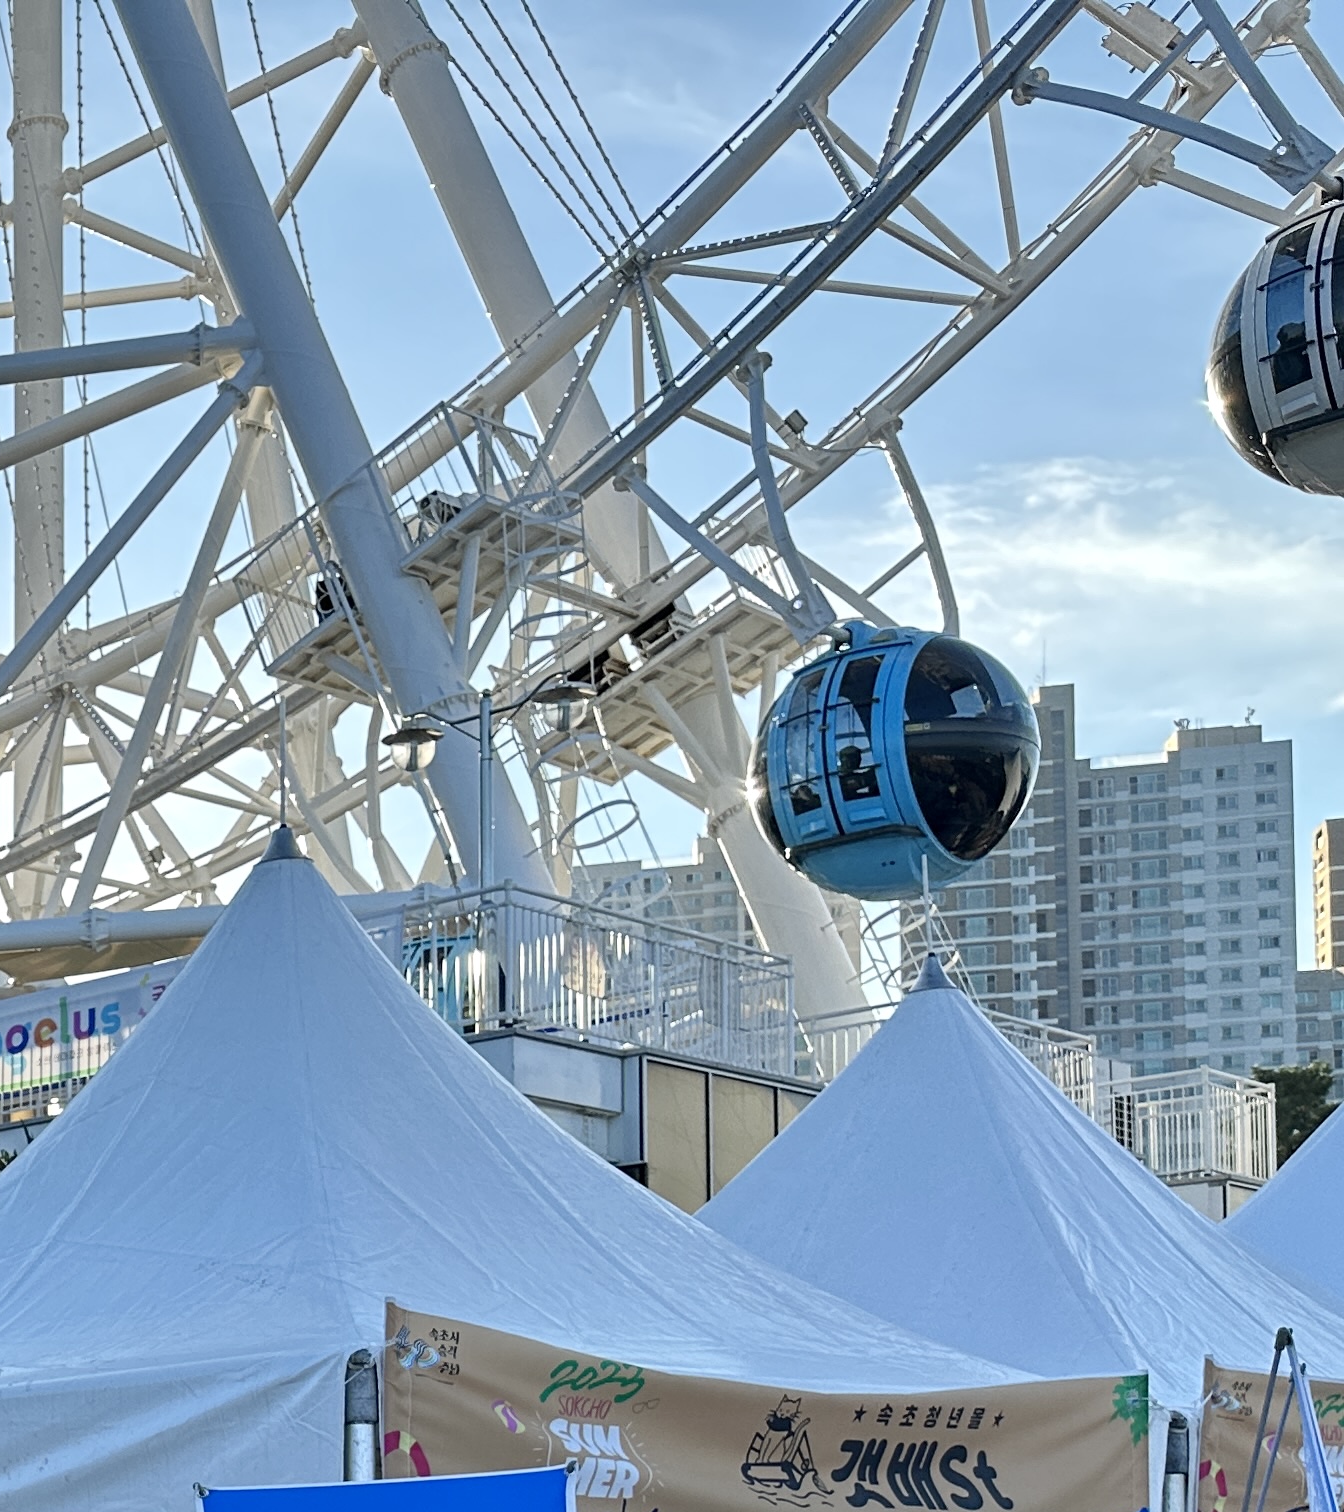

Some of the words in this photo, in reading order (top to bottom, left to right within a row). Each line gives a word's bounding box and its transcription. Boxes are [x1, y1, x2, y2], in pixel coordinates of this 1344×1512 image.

[539, 1360, 645, 1403] 2023
[558, 1395, 612, 1420] SOKCHO
[876, 1403, 986, 1430] 속초청년몰
[549, 1417, 630, 1460] SUM
[830, 1438, 1014, 1510] 갯배St
